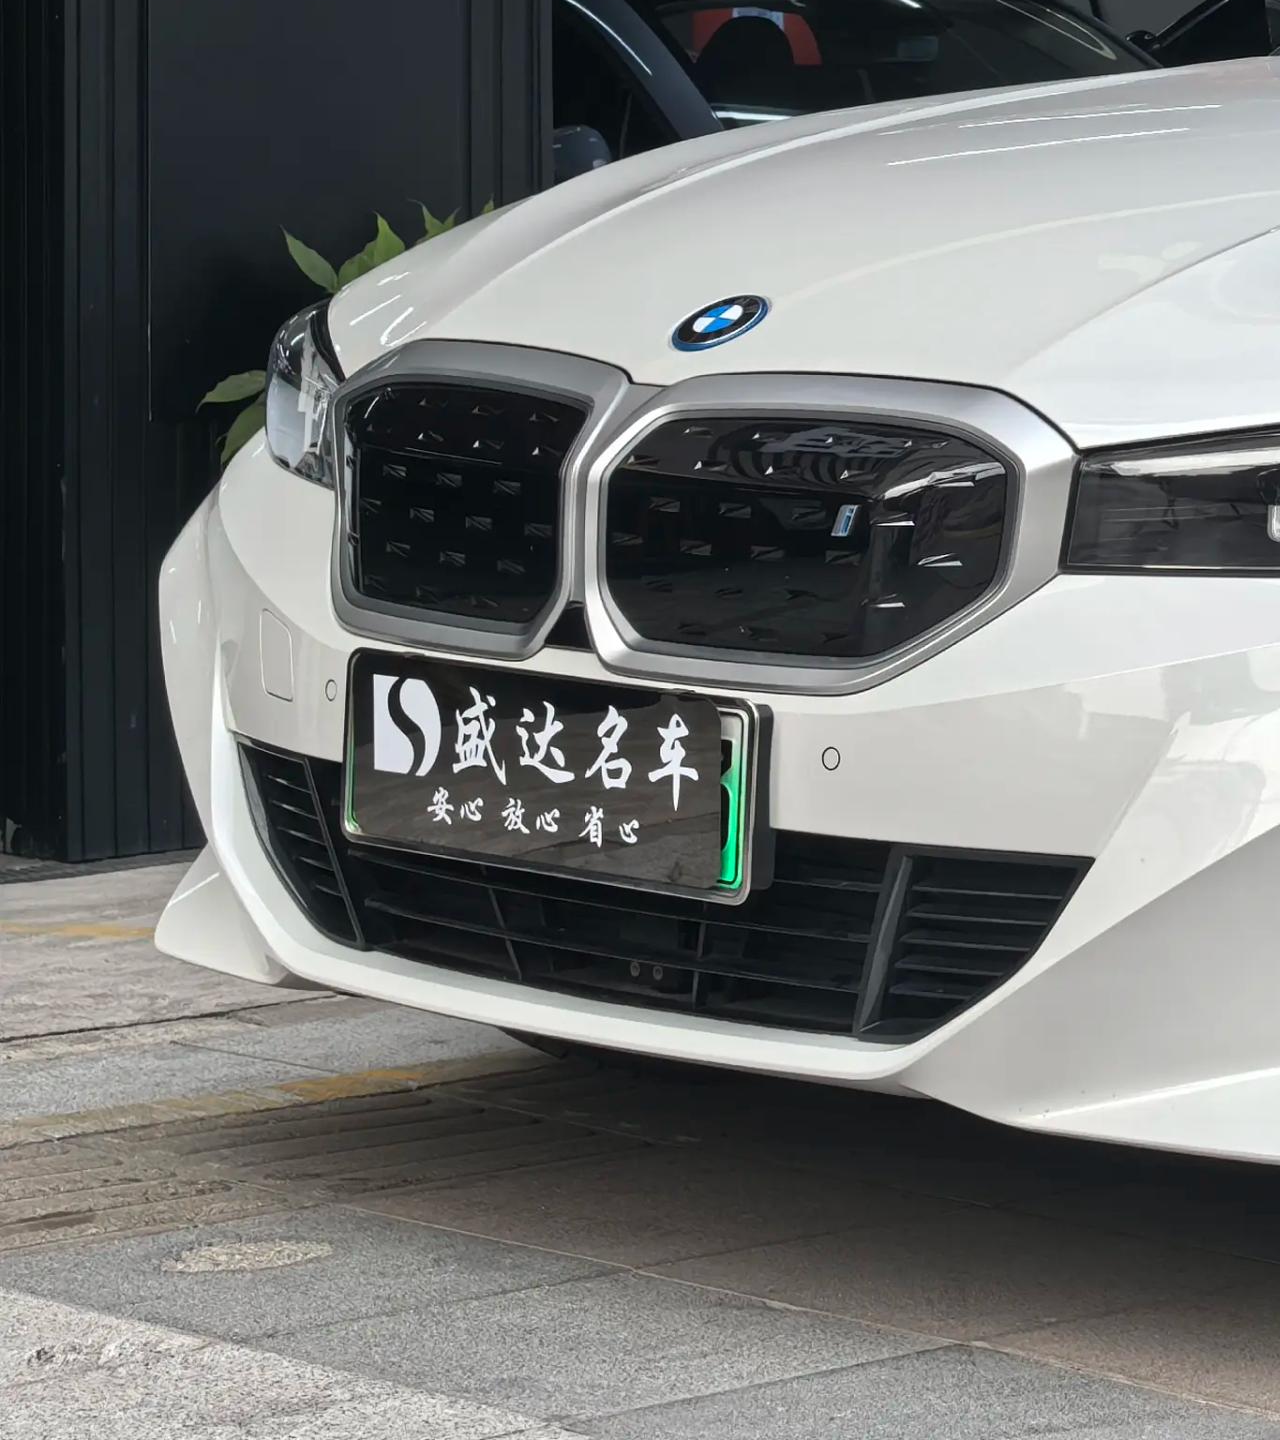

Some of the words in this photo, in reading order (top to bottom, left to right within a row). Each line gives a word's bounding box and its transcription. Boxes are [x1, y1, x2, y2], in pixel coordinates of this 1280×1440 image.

[452, 685, 699, 812] 盛达名车
[427, 786, 484, 825] 安心
[501, 797, 561, 835] 放心
[578, 806, 641, 848] 省心
